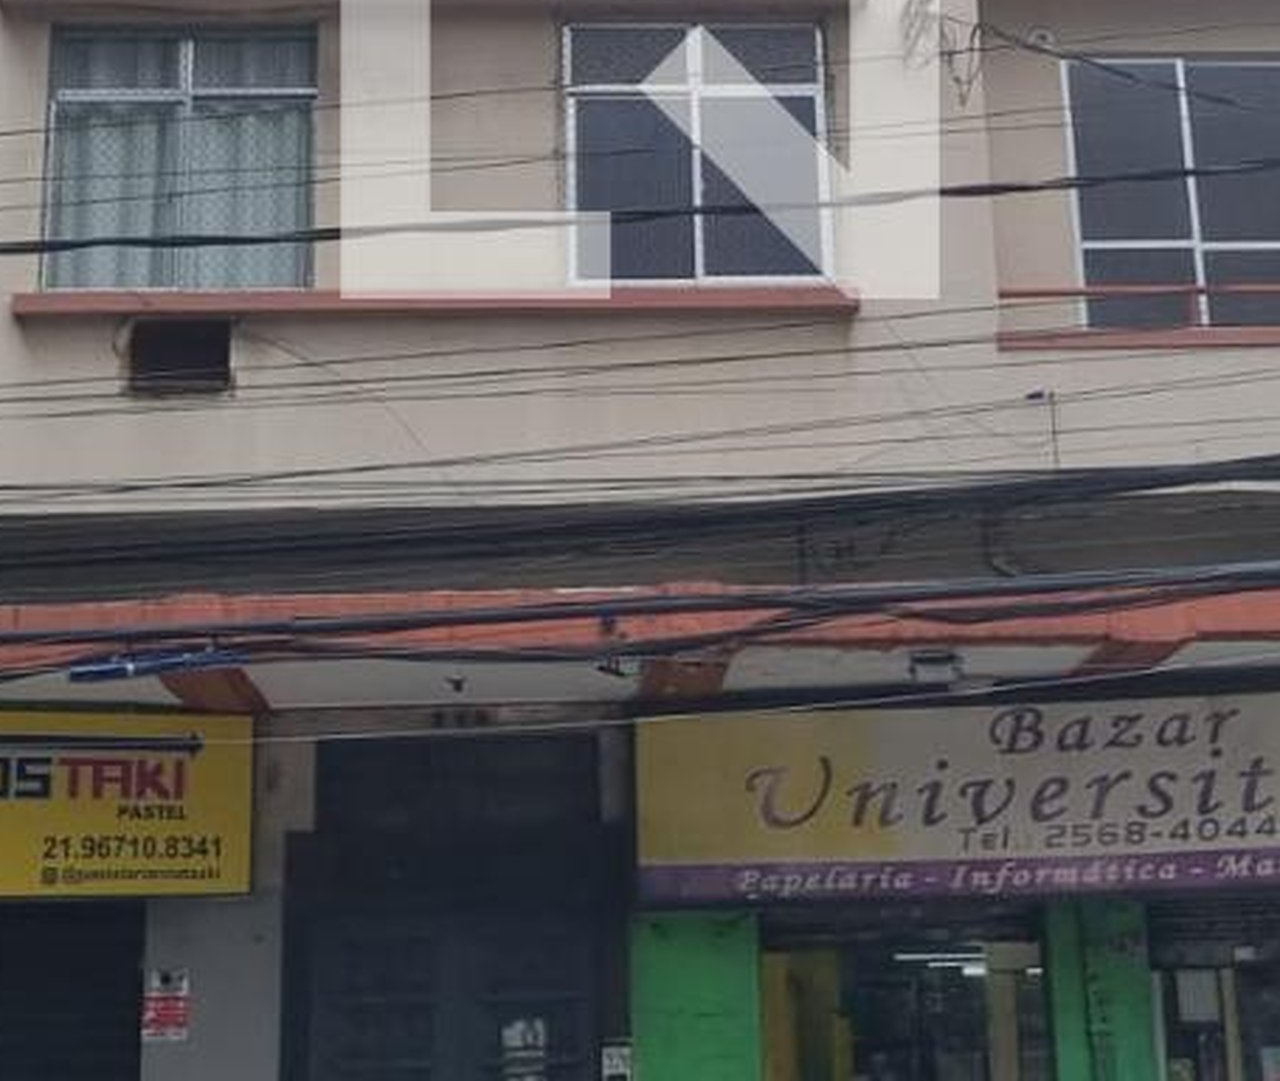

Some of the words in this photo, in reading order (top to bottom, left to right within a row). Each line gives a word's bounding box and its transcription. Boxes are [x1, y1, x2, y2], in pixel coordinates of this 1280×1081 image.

[988, 705, 1240, 755] Bazar
[116, 804, 187, 820] PASTEL
[43, 835, 222, 860] 21.96710.8341
[1044, 814, 1280, 849] 2568-4044
[739, 866, 915, 900] Papelaria
[949, 857, 1178, 894] Informática
